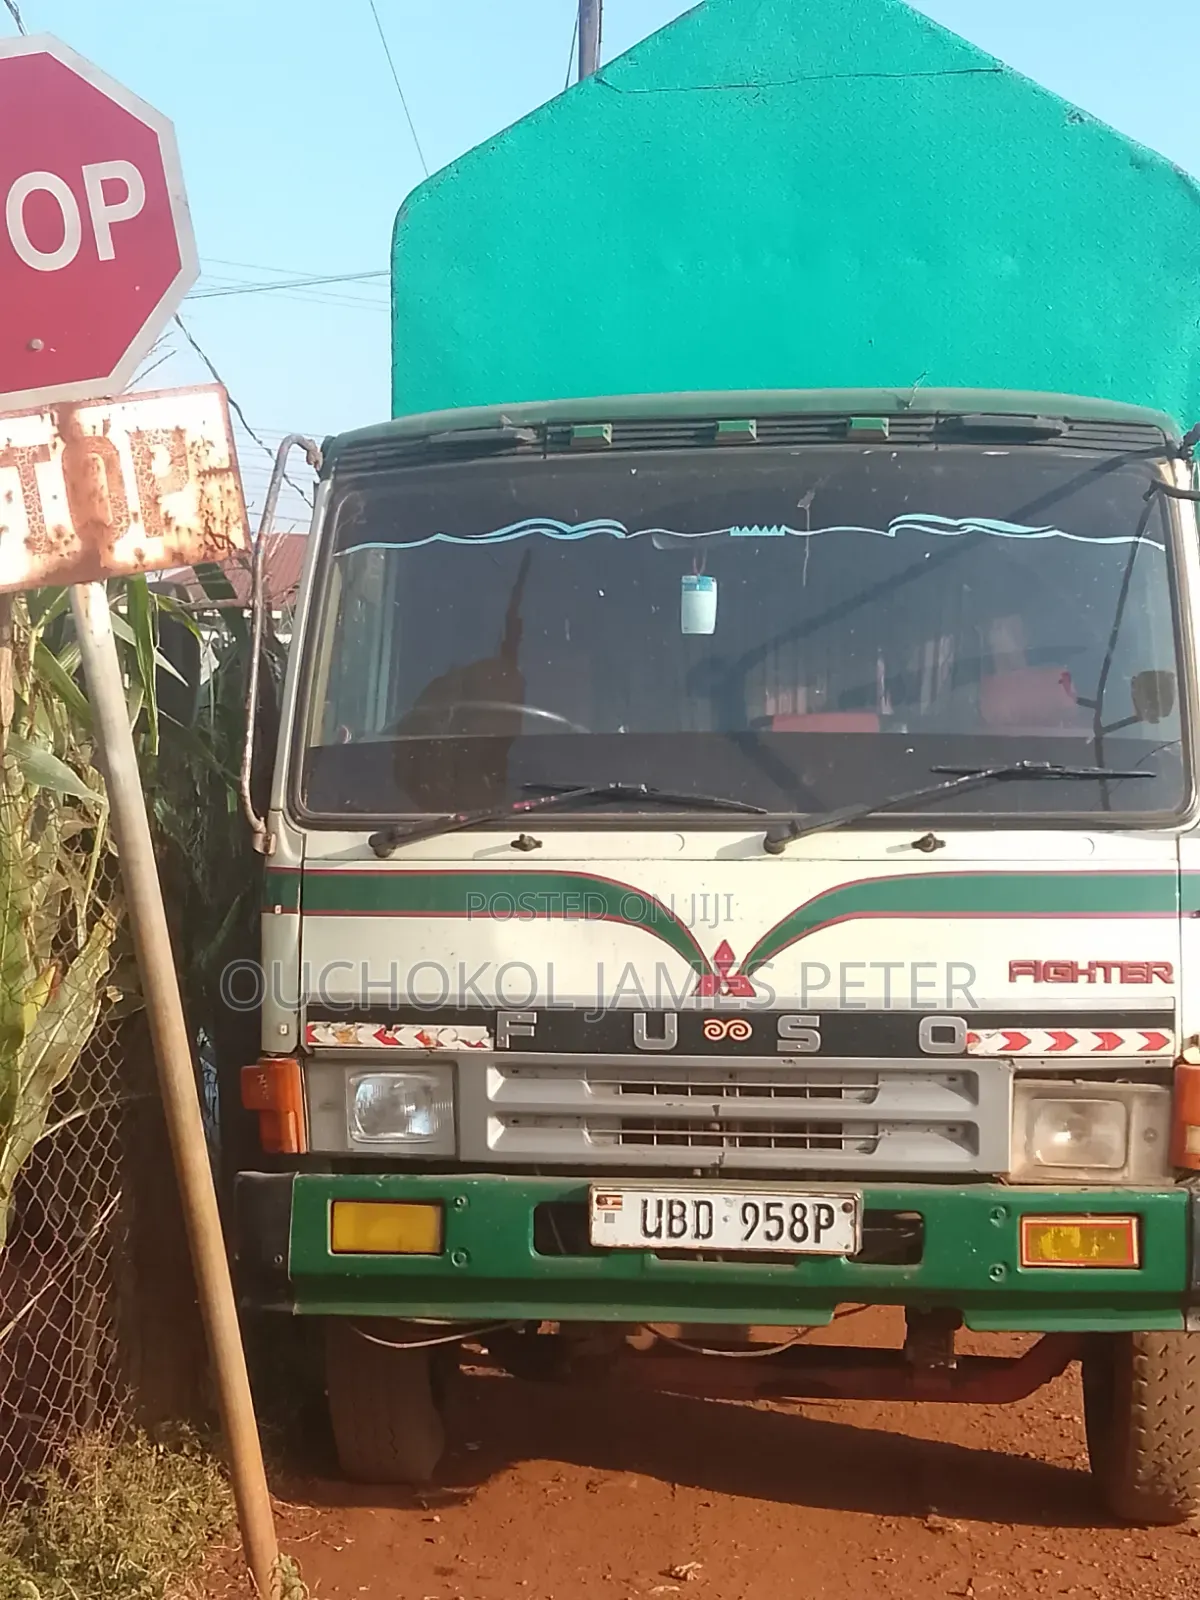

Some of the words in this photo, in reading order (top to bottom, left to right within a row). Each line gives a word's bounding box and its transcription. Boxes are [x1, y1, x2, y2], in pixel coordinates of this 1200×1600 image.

[1008, 959, 1175, 984] FIGHTER
[640, 1197, 714, 1240] UBD
[740, 1202, 835, 1244] 958P
